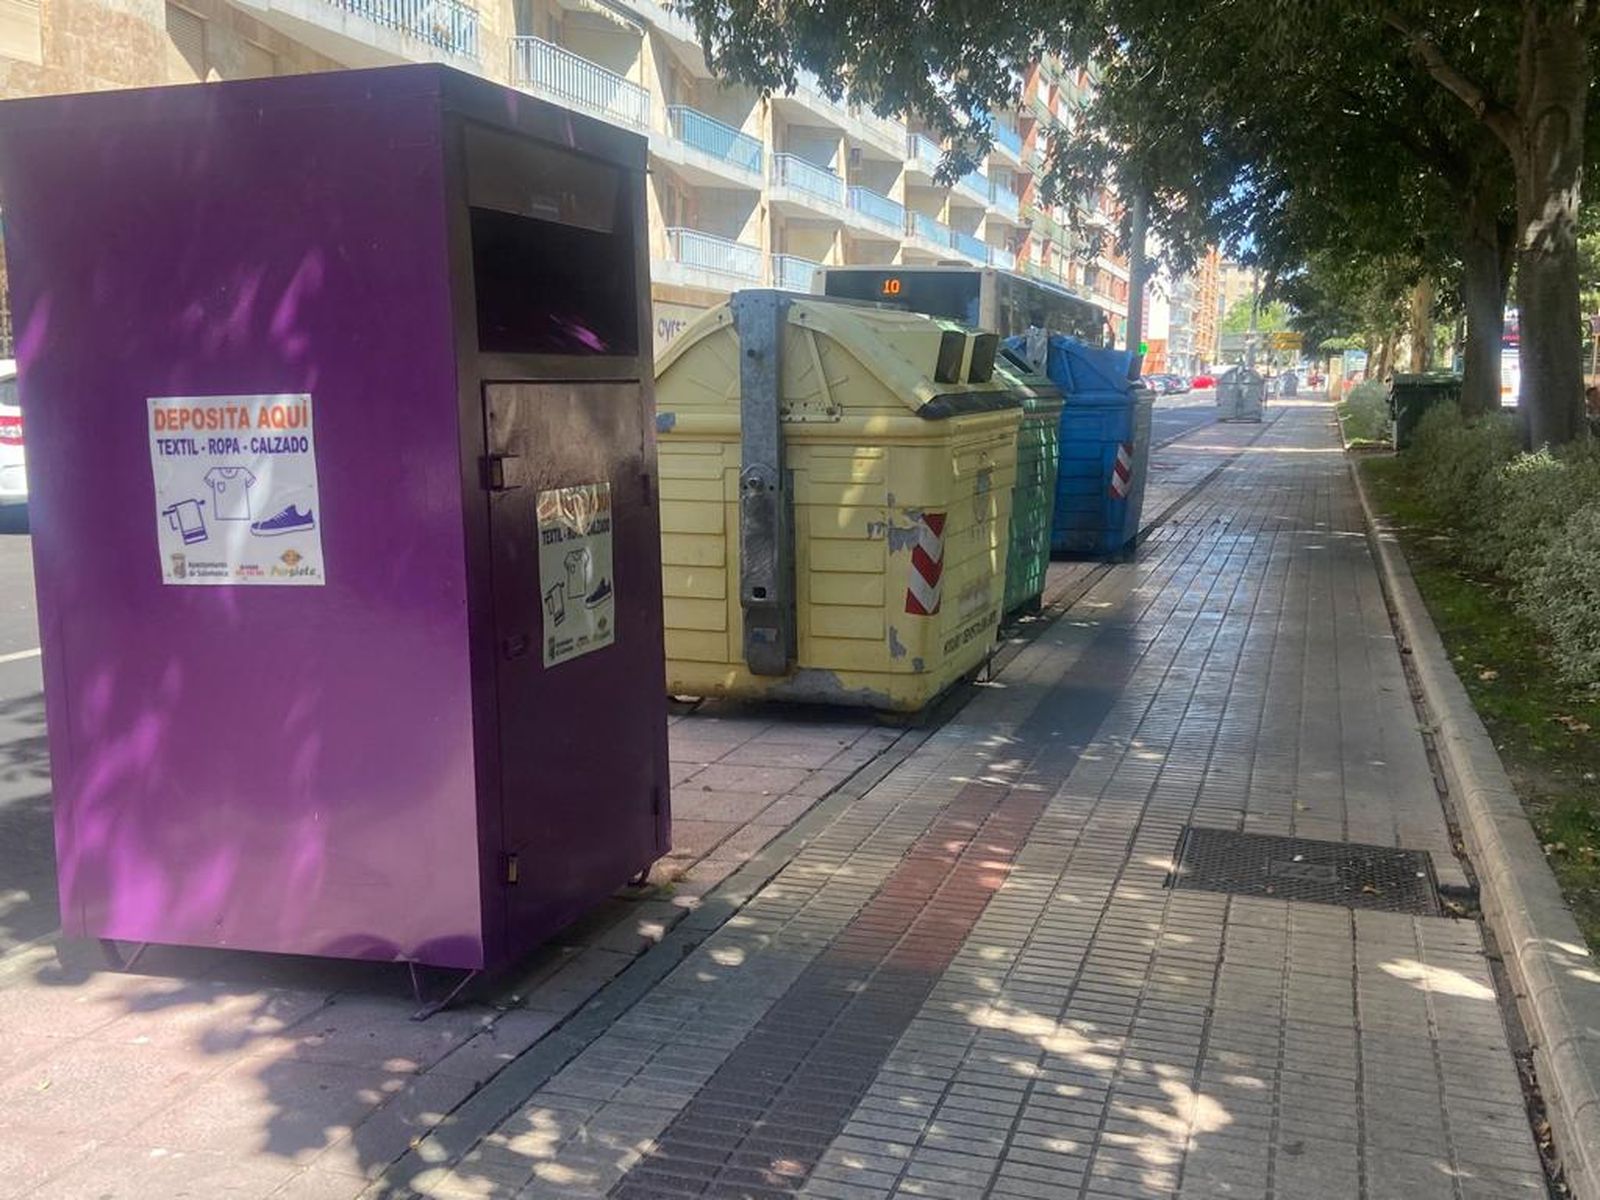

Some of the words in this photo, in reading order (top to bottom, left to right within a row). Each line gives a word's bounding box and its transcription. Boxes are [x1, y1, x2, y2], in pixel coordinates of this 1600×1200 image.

[883, 279, 900, 294] 10
[154, 404, 250, 431] DEPOSITA
[257, 399, 309, 428] AQUÍ
[157, 438, 199, 456] TEXTIL
[208, 437, 240, 454] ROPA
[251, 436, 309, 453] CALZADO
